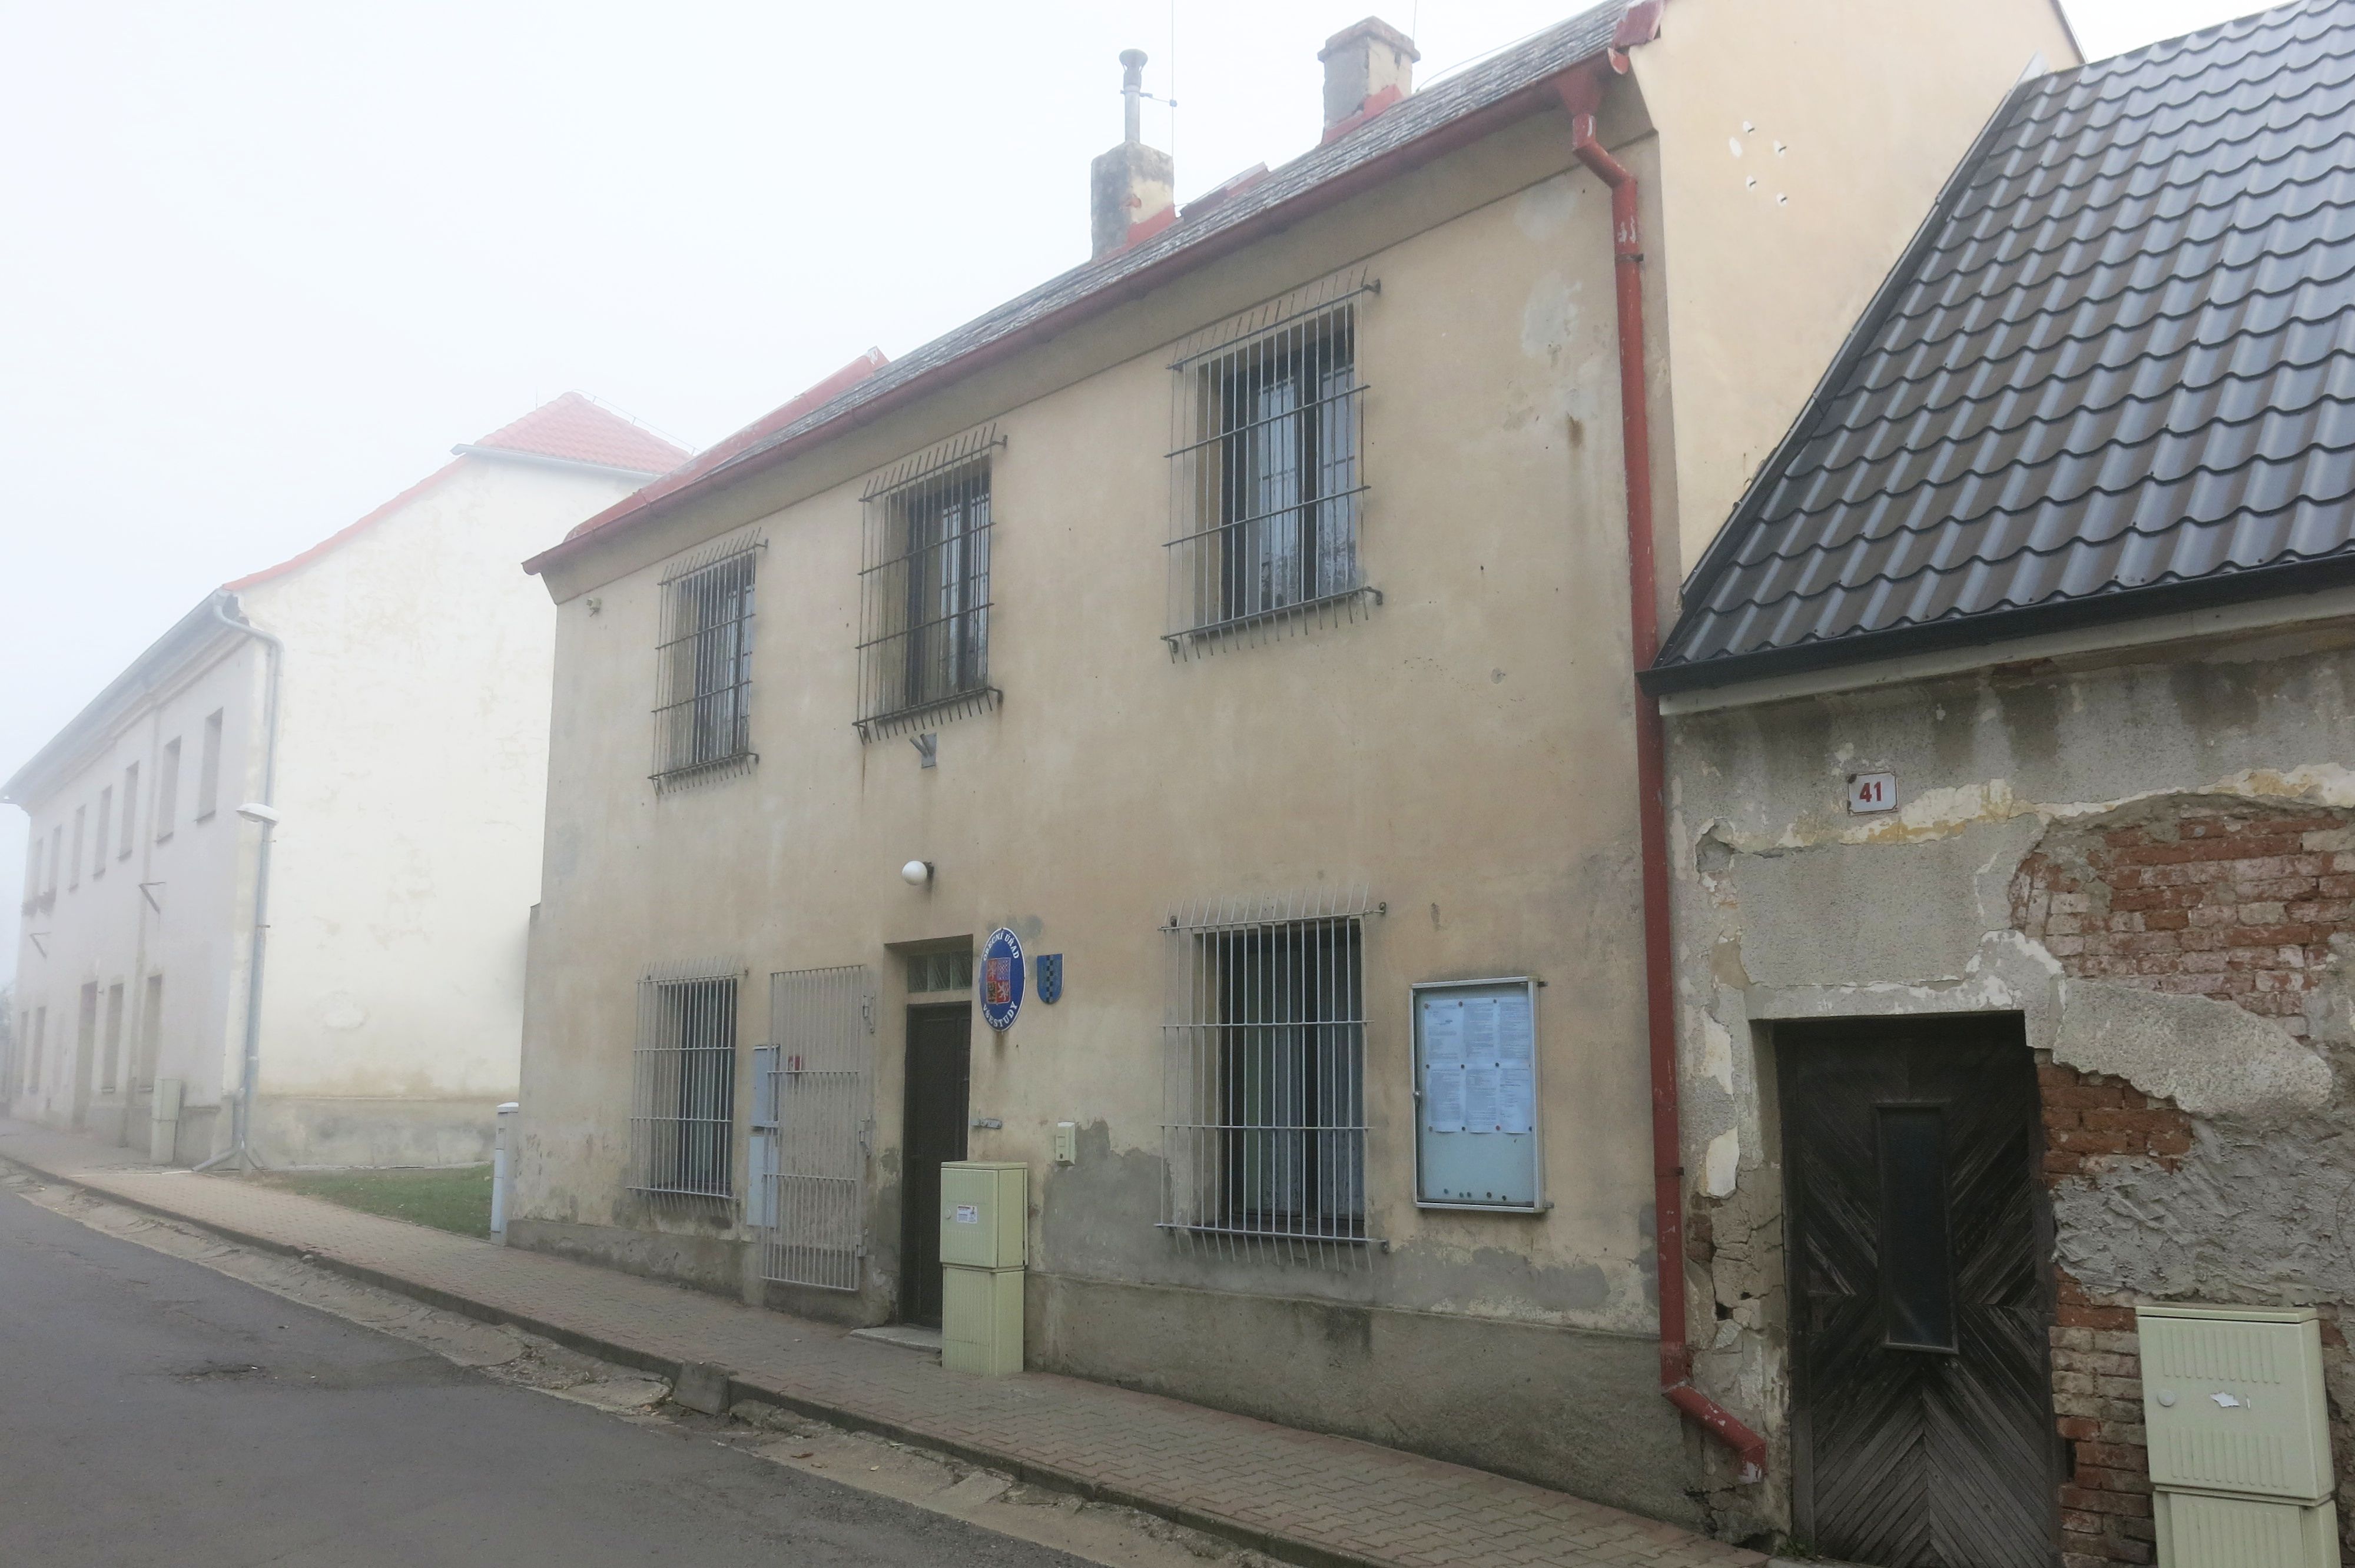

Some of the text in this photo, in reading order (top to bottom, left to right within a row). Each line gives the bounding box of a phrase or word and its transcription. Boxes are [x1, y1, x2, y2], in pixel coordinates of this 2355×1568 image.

[1859, 781, 1882, 802] 41
[983, 930, 1020, 961] OBECNÍ ÚŘAD
[983, 1001, 1018, 1027] VŠESTUDY
